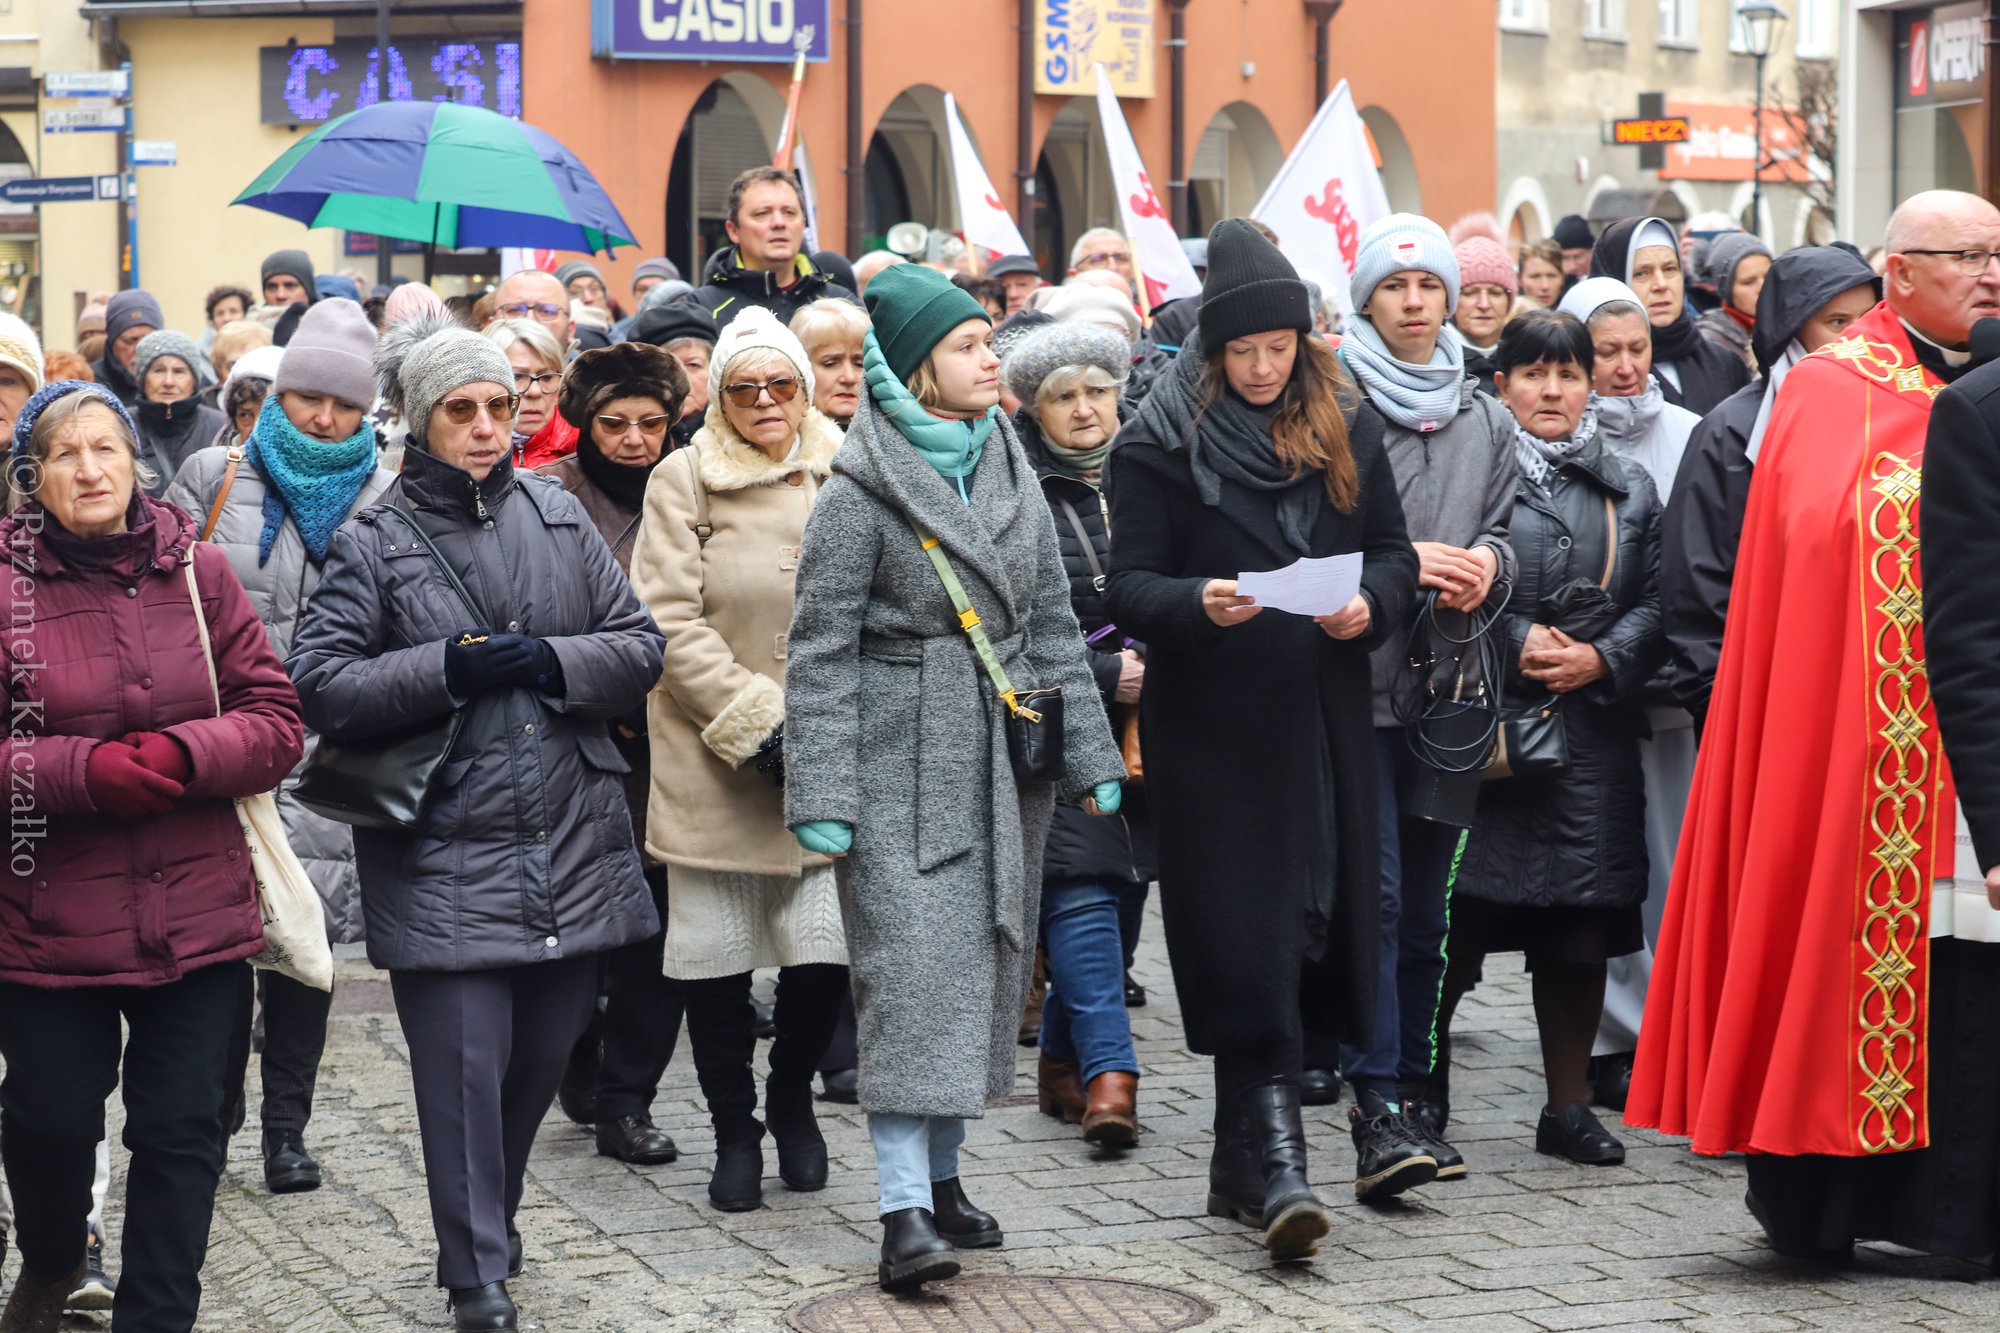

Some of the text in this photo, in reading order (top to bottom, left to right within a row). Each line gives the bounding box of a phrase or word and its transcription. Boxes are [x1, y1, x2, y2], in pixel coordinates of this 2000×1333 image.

[639, 0, 795, 43] CASIO
[1045, 0, 1069, 85] GSM
[284, 43, 520, 119] CASI
